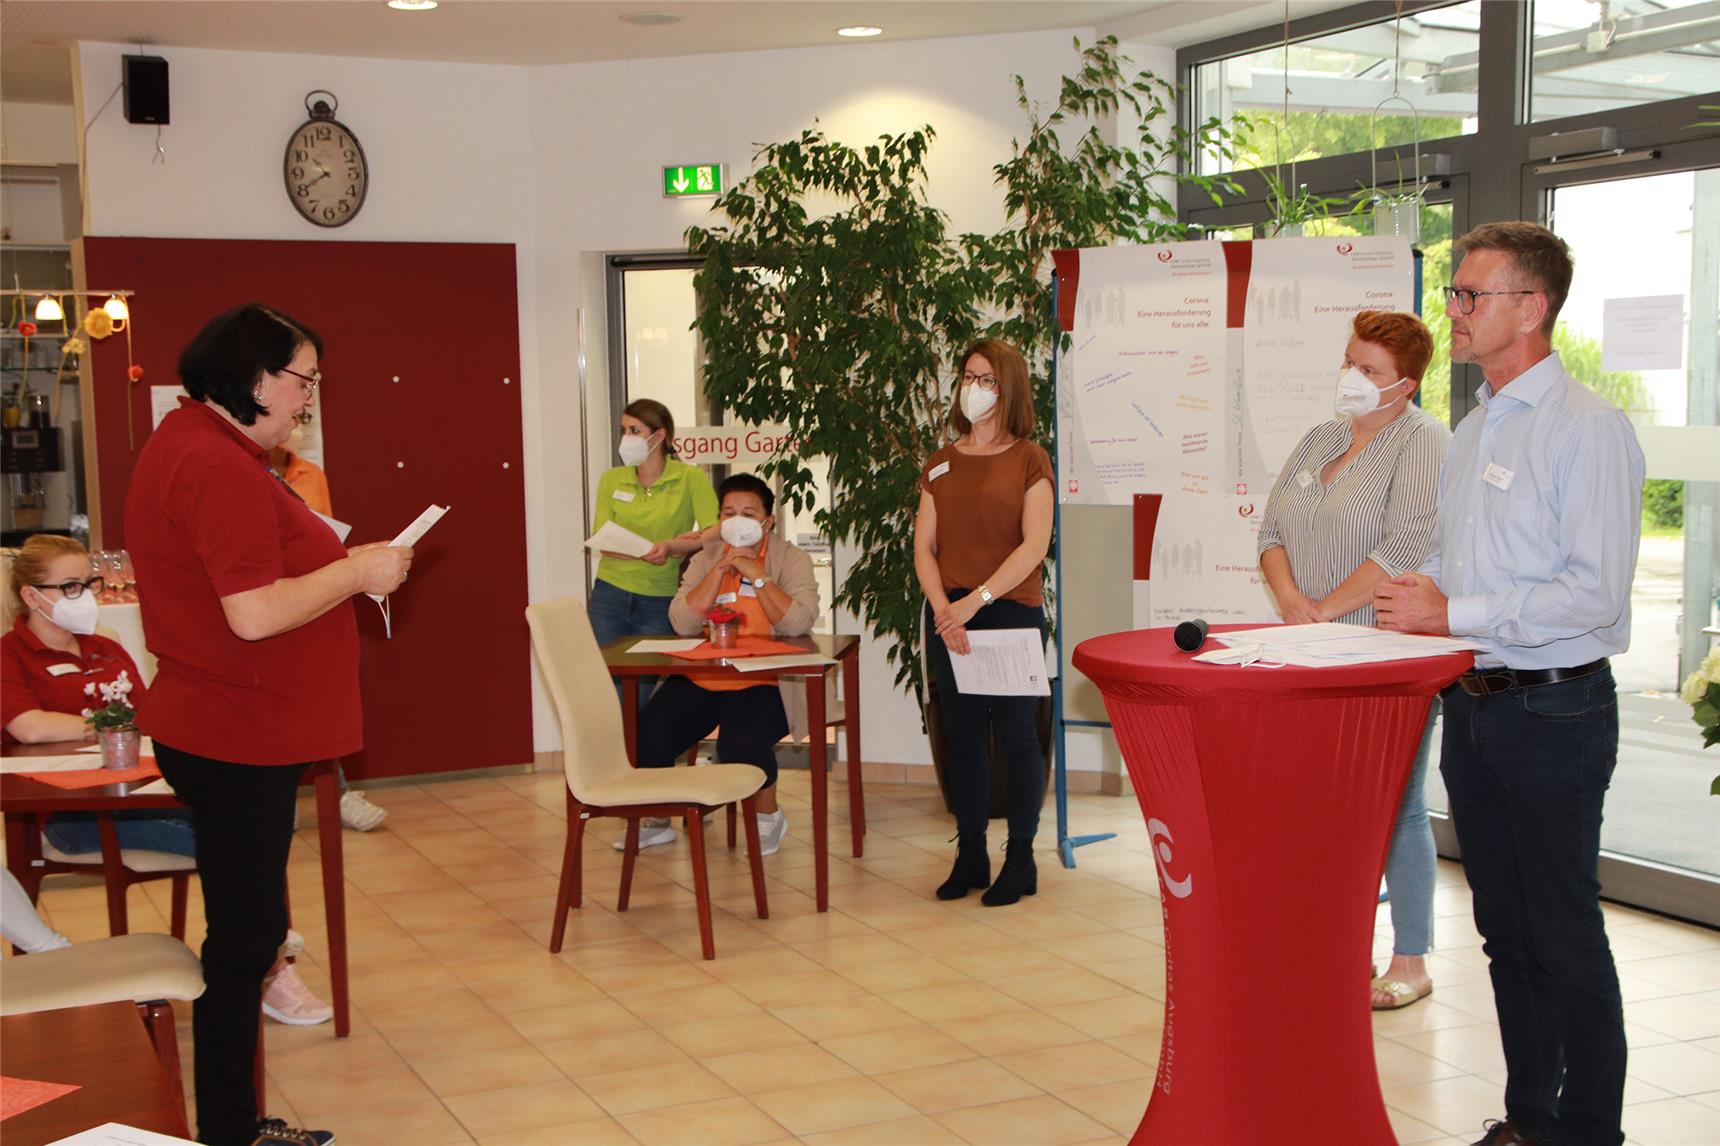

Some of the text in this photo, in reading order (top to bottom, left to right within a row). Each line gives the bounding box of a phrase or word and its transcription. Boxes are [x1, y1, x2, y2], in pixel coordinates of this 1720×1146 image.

[303, 134, 315, 148] 11
[315, 127, 332, 141] 12
[338, 134, 344, 148] 1
[294, 149, 309, 163] 10
[343, 149, 357, 163] 2
[292, 166, 305, 181] 9
[297, 184, 310, 198] 8
[345, 184, 356, 198] 4
[308, 199, 319, 214] 7
[337, 199, 350, 213] 5
[322, 206, 335, 221] 6
[1137, 309, 1211, 318] Eine Herausforderung
[1313, 303, 1396, 314] Eine Herausforderung
[1171, 321, 1181, 329] für
[673, 431, 811, 460] sgang Garte
[1215, 564, 1230, 572] Eine
[1162, 997, 1176, 1095] Augsburg
